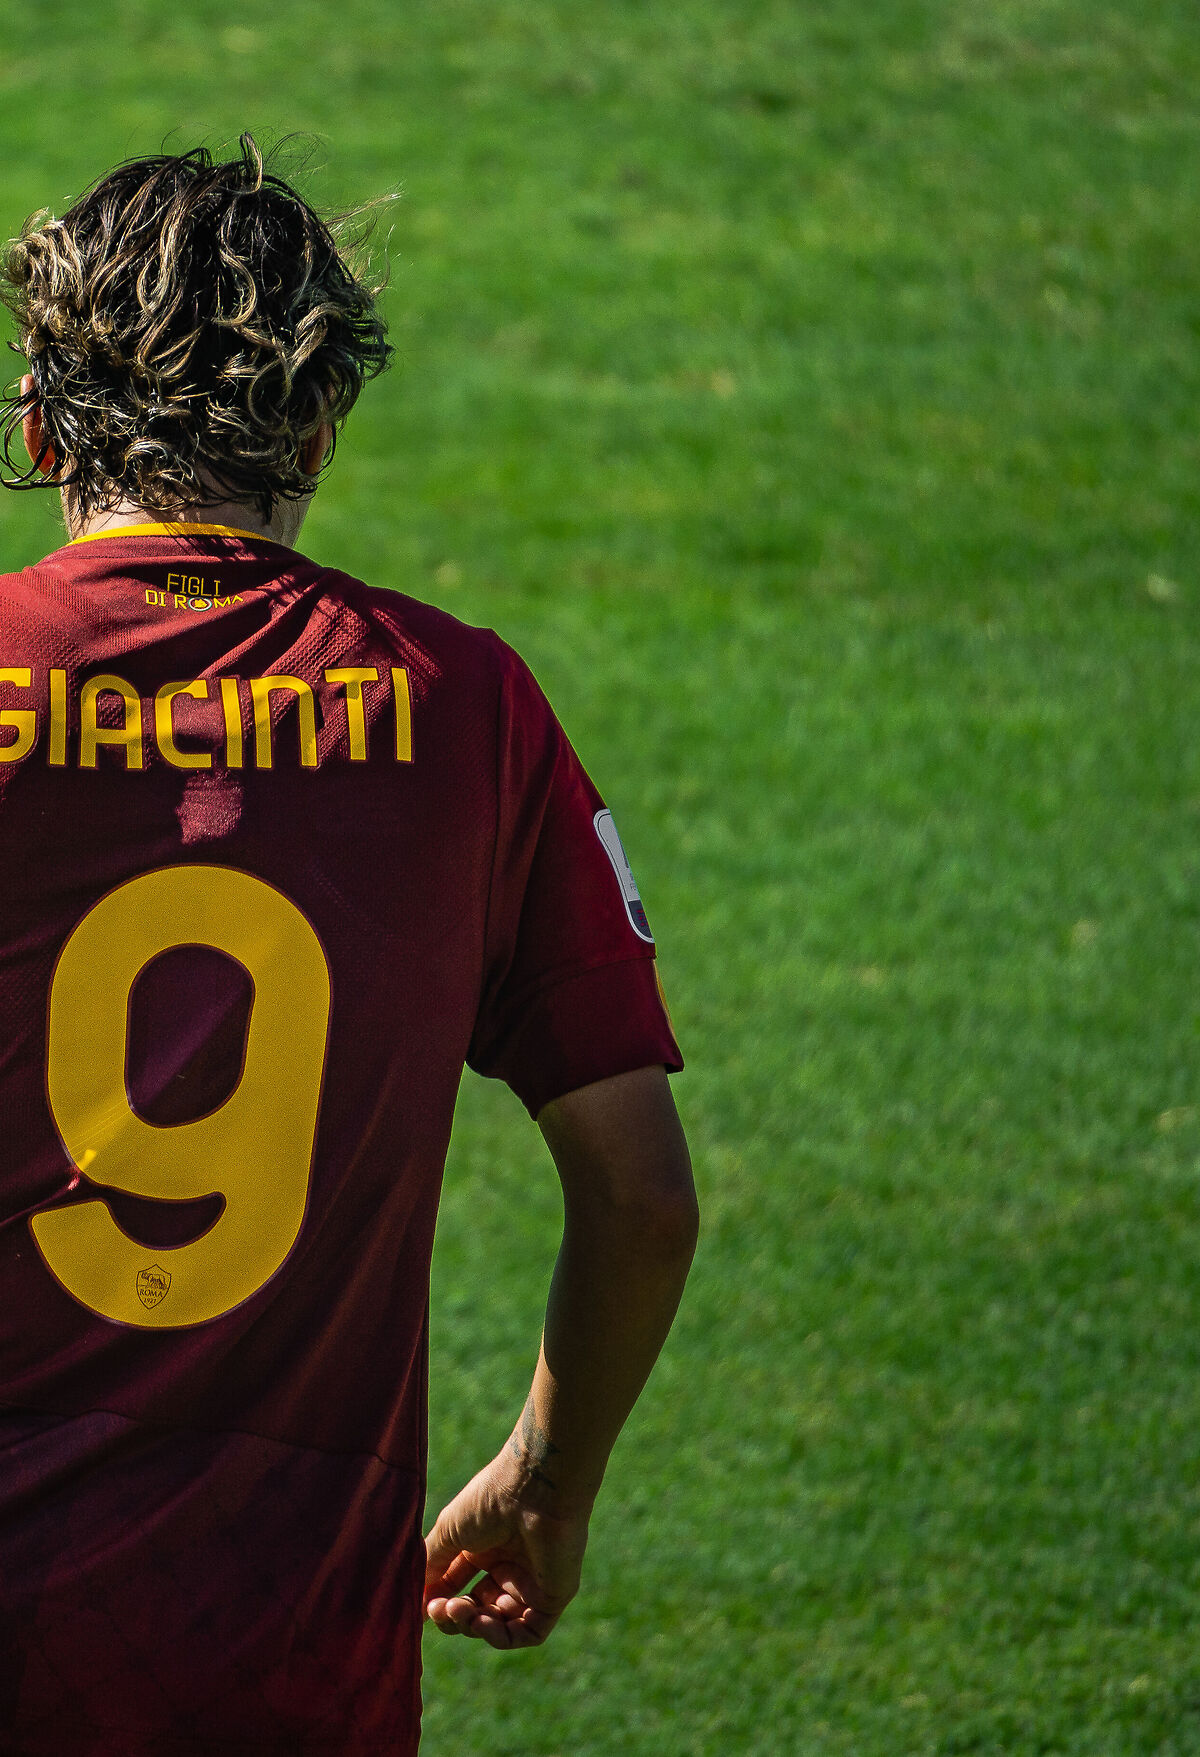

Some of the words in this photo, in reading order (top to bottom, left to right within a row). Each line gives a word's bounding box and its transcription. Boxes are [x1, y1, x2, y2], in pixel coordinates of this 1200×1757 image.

[167, 573, 221, 597] FIGLI
[145, 589, 166, 607] DI
[31, 864, 331, 1328] 9
[140, 1289, 163, 1298] ROMA
